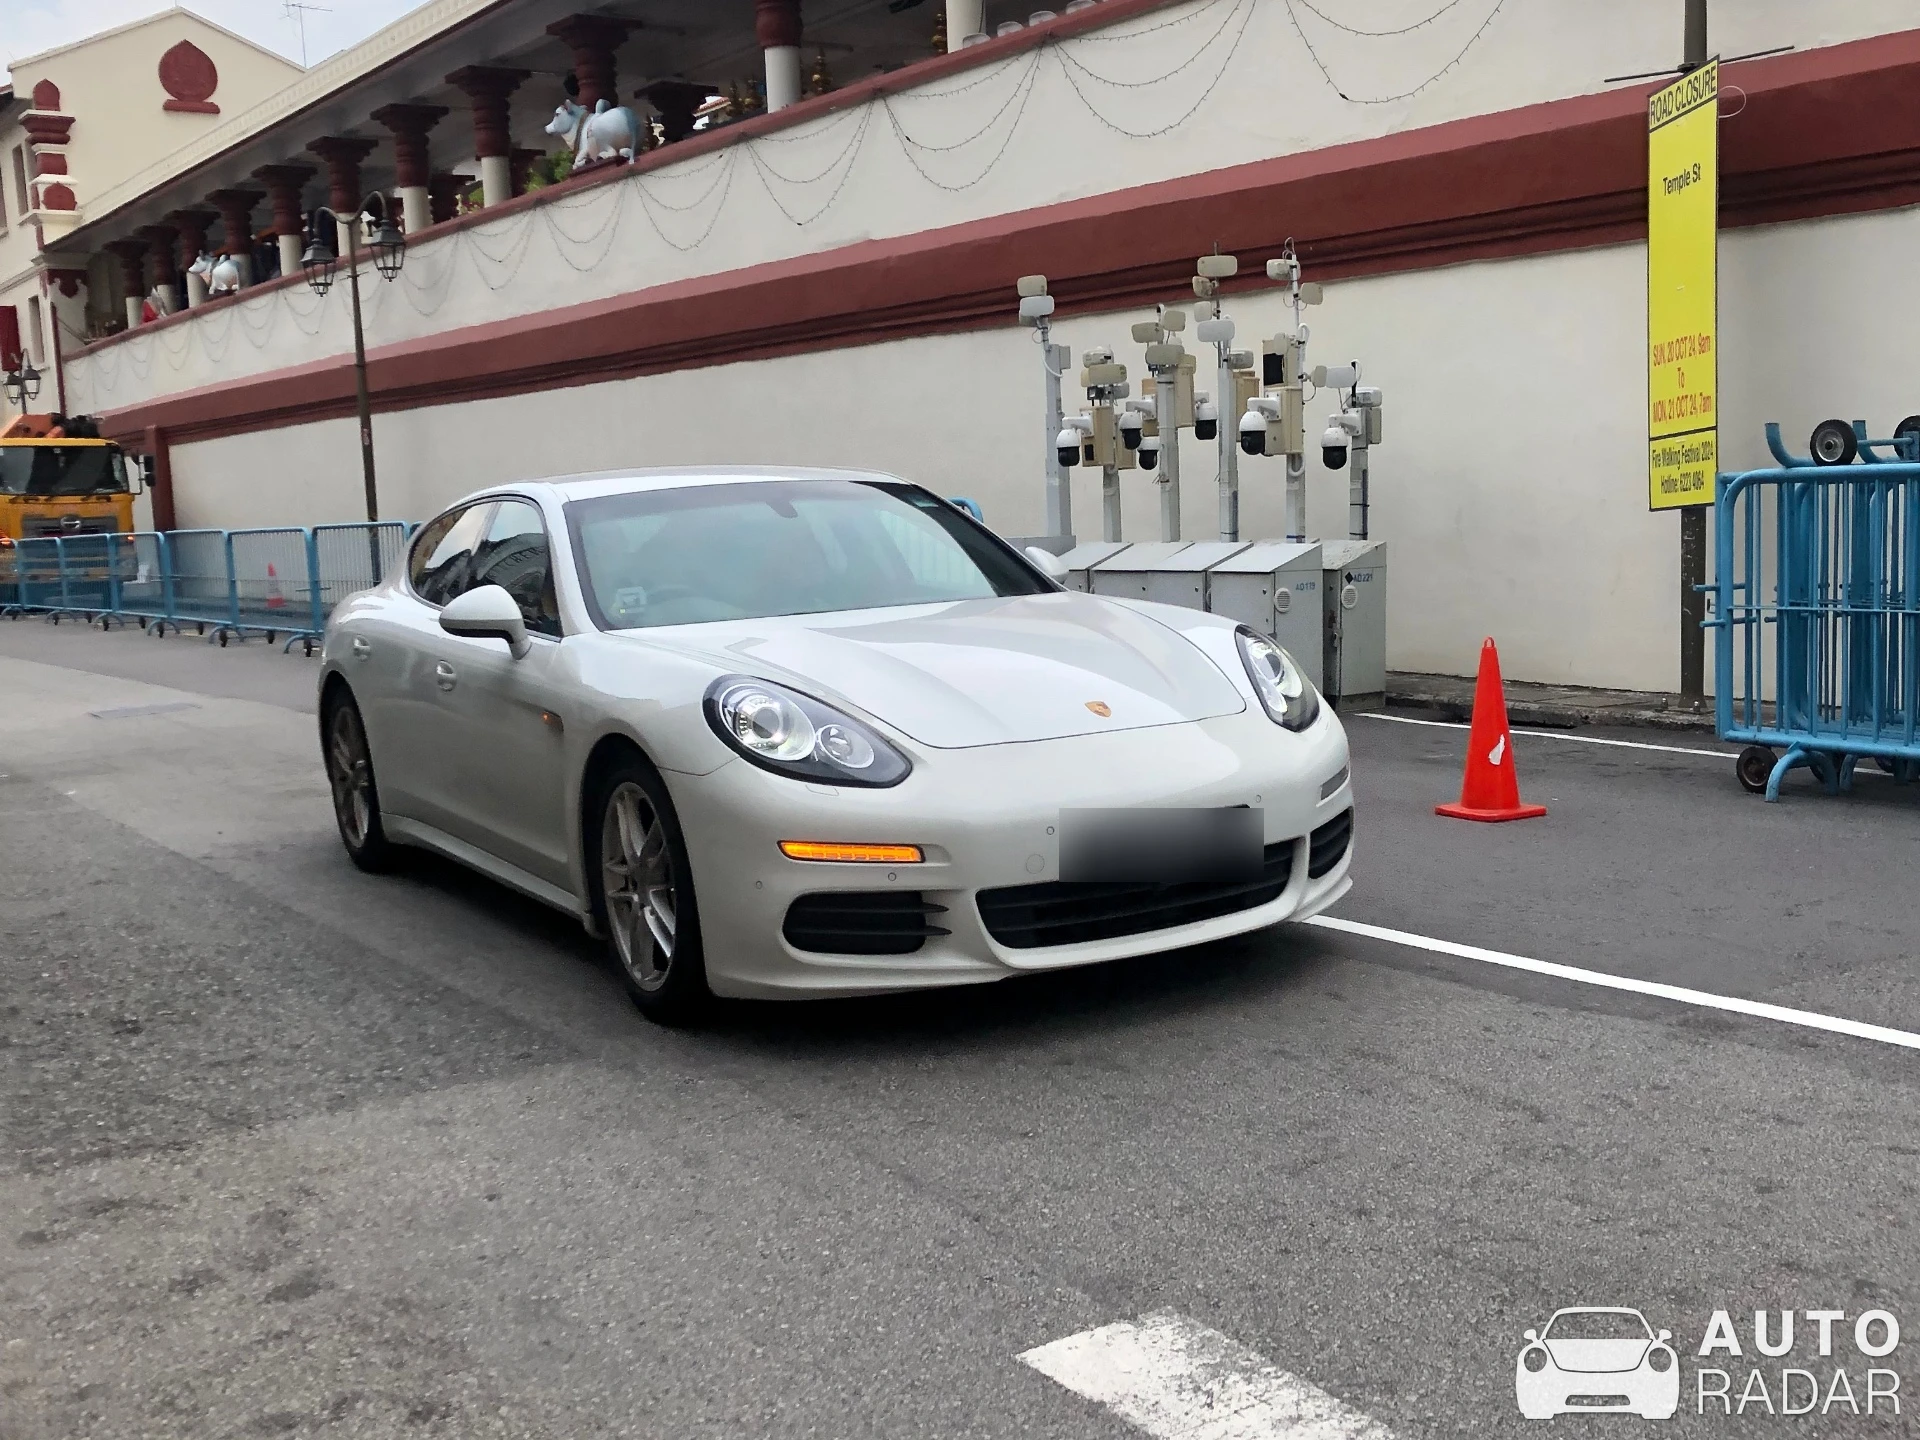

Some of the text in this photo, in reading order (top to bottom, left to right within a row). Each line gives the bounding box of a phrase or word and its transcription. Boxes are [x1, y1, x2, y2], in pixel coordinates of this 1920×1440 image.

[1650, 65, 1716, 124] ROAD CLOSURE
[1663, 163, 1701, 196] Temple St
[1667, 341, 1675, 363] 20
[1675, 336, 1688, 361] OCT
[1698, 332, 1711, 355] 9am
[1677, 366, 1685, 389] To
[1668, 397, 1675, 420] 21
[1675, 394, 1689, 419] OCT
[1699, 392, 1712, 415] 7am
[1652, 441, 1713, 470] Fire Walking Festival 2024
